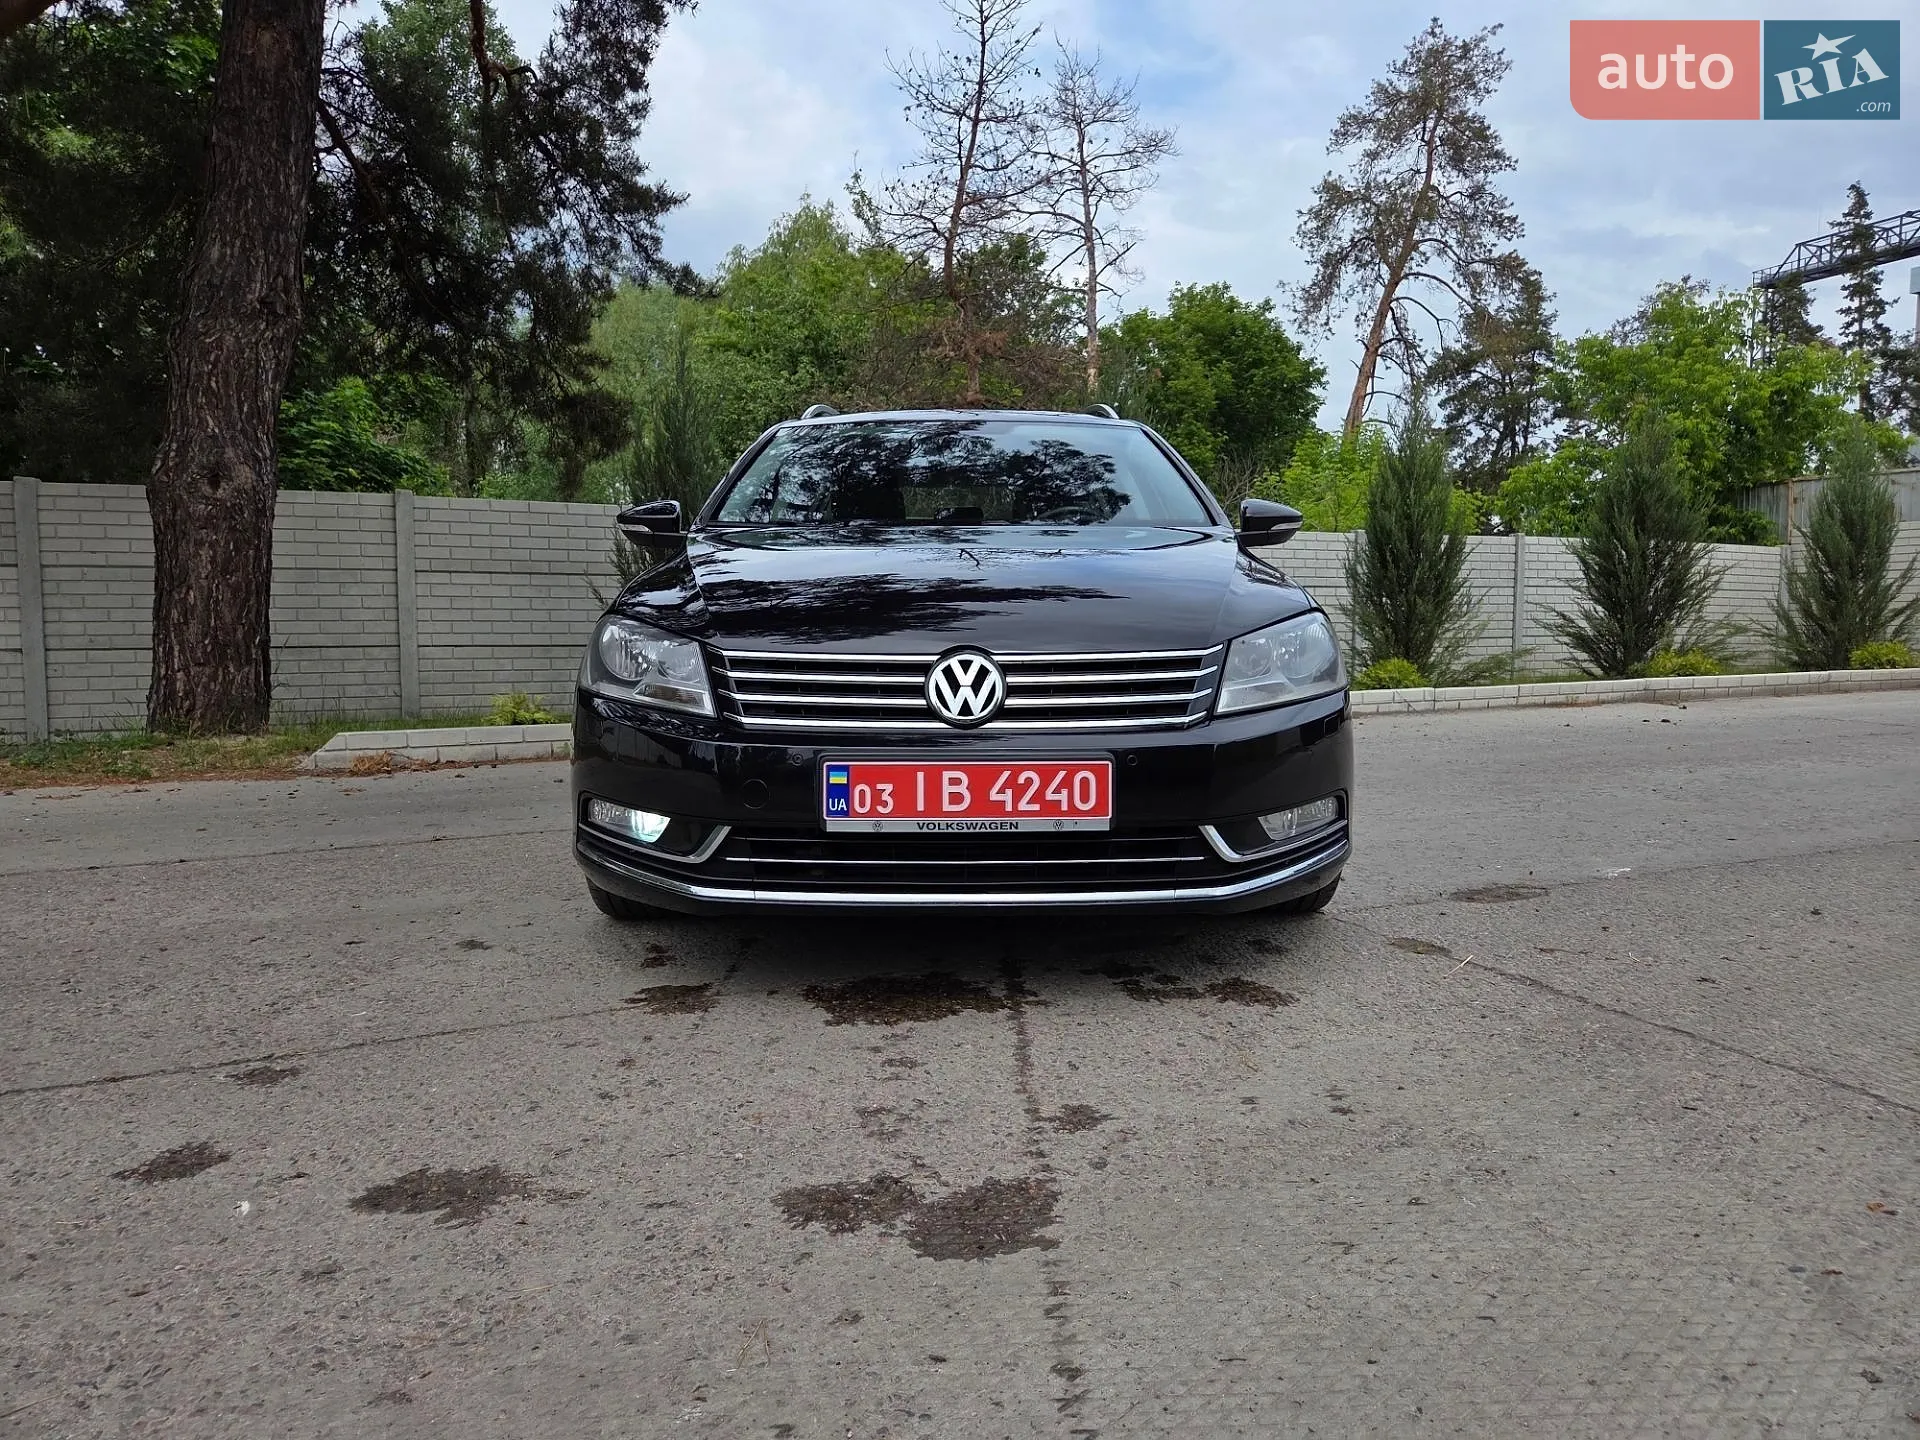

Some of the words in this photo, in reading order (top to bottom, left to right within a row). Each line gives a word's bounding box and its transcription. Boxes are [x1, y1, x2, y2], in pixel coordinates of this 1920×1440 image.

[853, 783, 894, 814] 03
[989, 770, 1097, 812] 4240
[829, 798, 847, 811] UA
[916, 821, 1019, 831] VOLKSWAGEN
